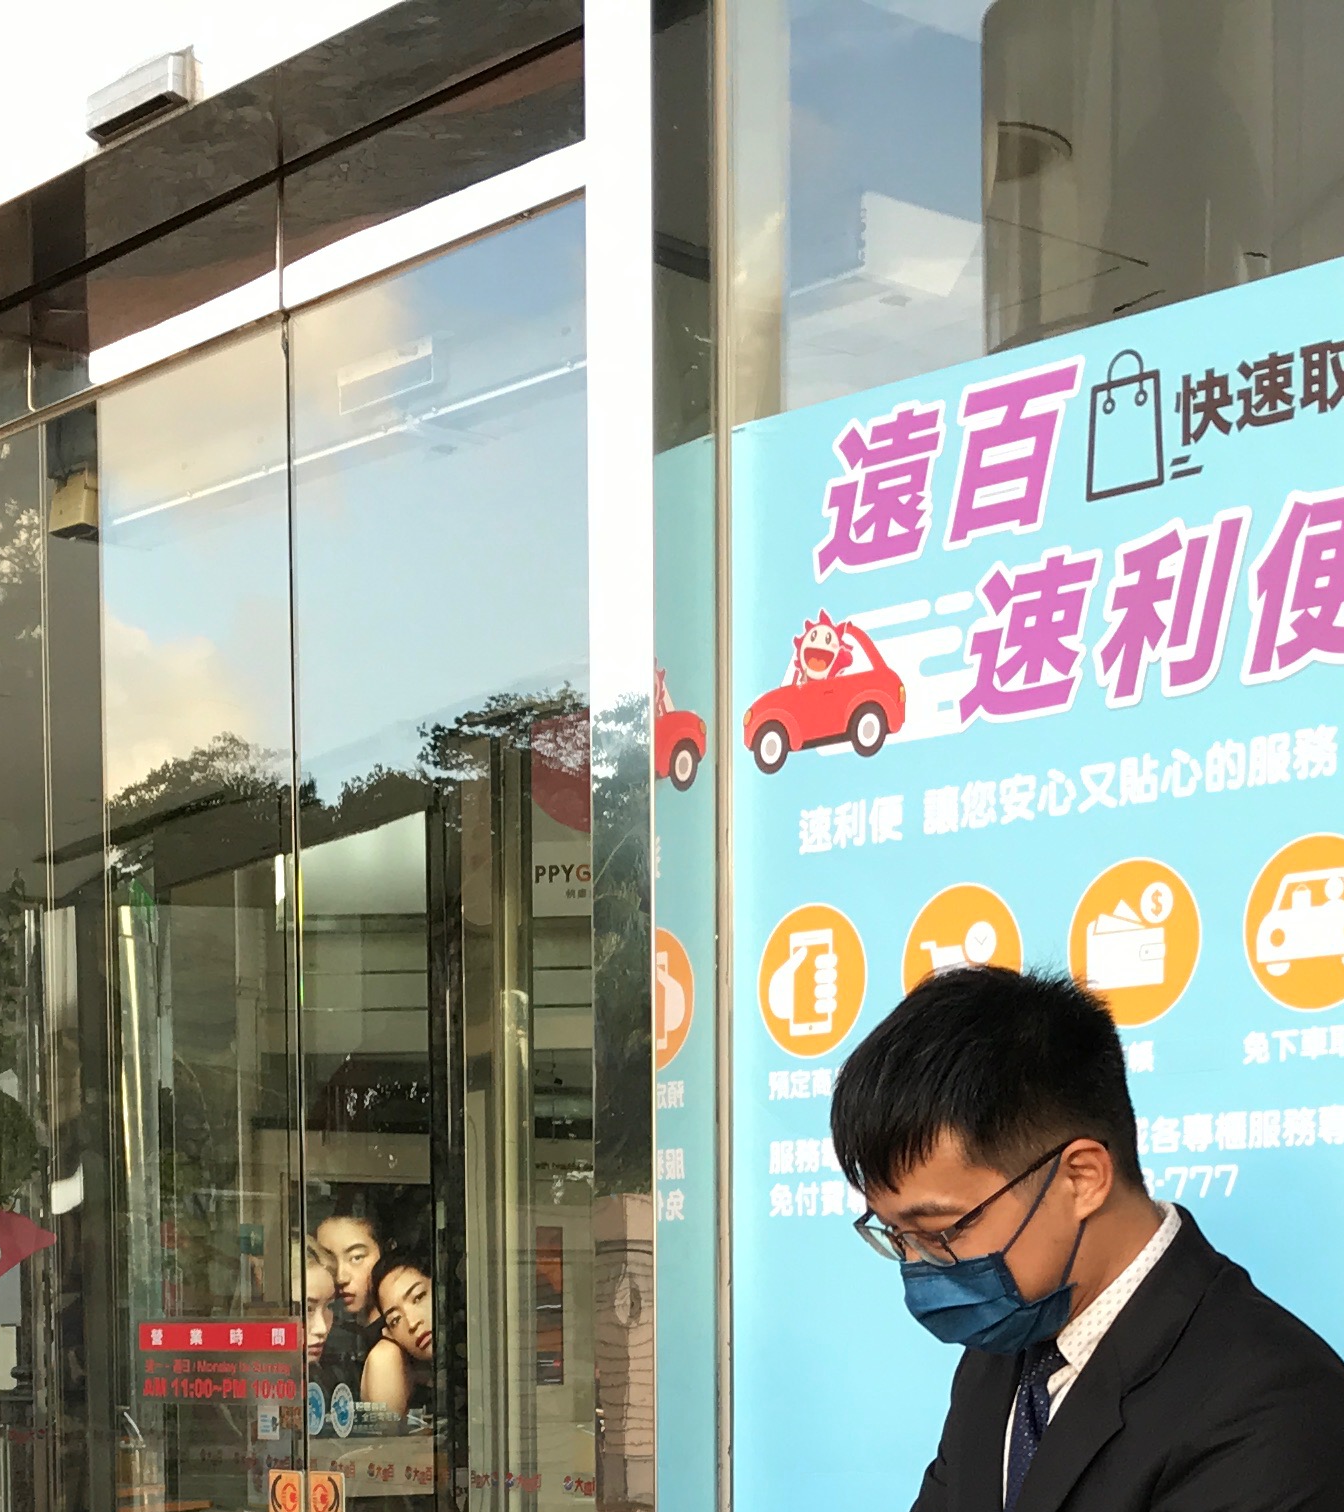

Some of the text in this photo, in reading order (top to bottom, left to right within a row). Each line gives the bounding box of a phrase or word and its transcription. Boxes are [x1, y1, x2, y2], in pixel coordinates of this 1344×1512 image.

[818, 365, 1080, 577] 遠百
[798, 726, 1340, 855] 速利便 讓您安心又貼心的服務
[1123, 1041, 1154, 1072] 帳
[768, 1067, 843, 1100] 預定商
[150, 1328, 287, 1346] 營業時間
[143, 1377, 167, 1397] AM
[252, 1378, 296, 1399] 10:00
